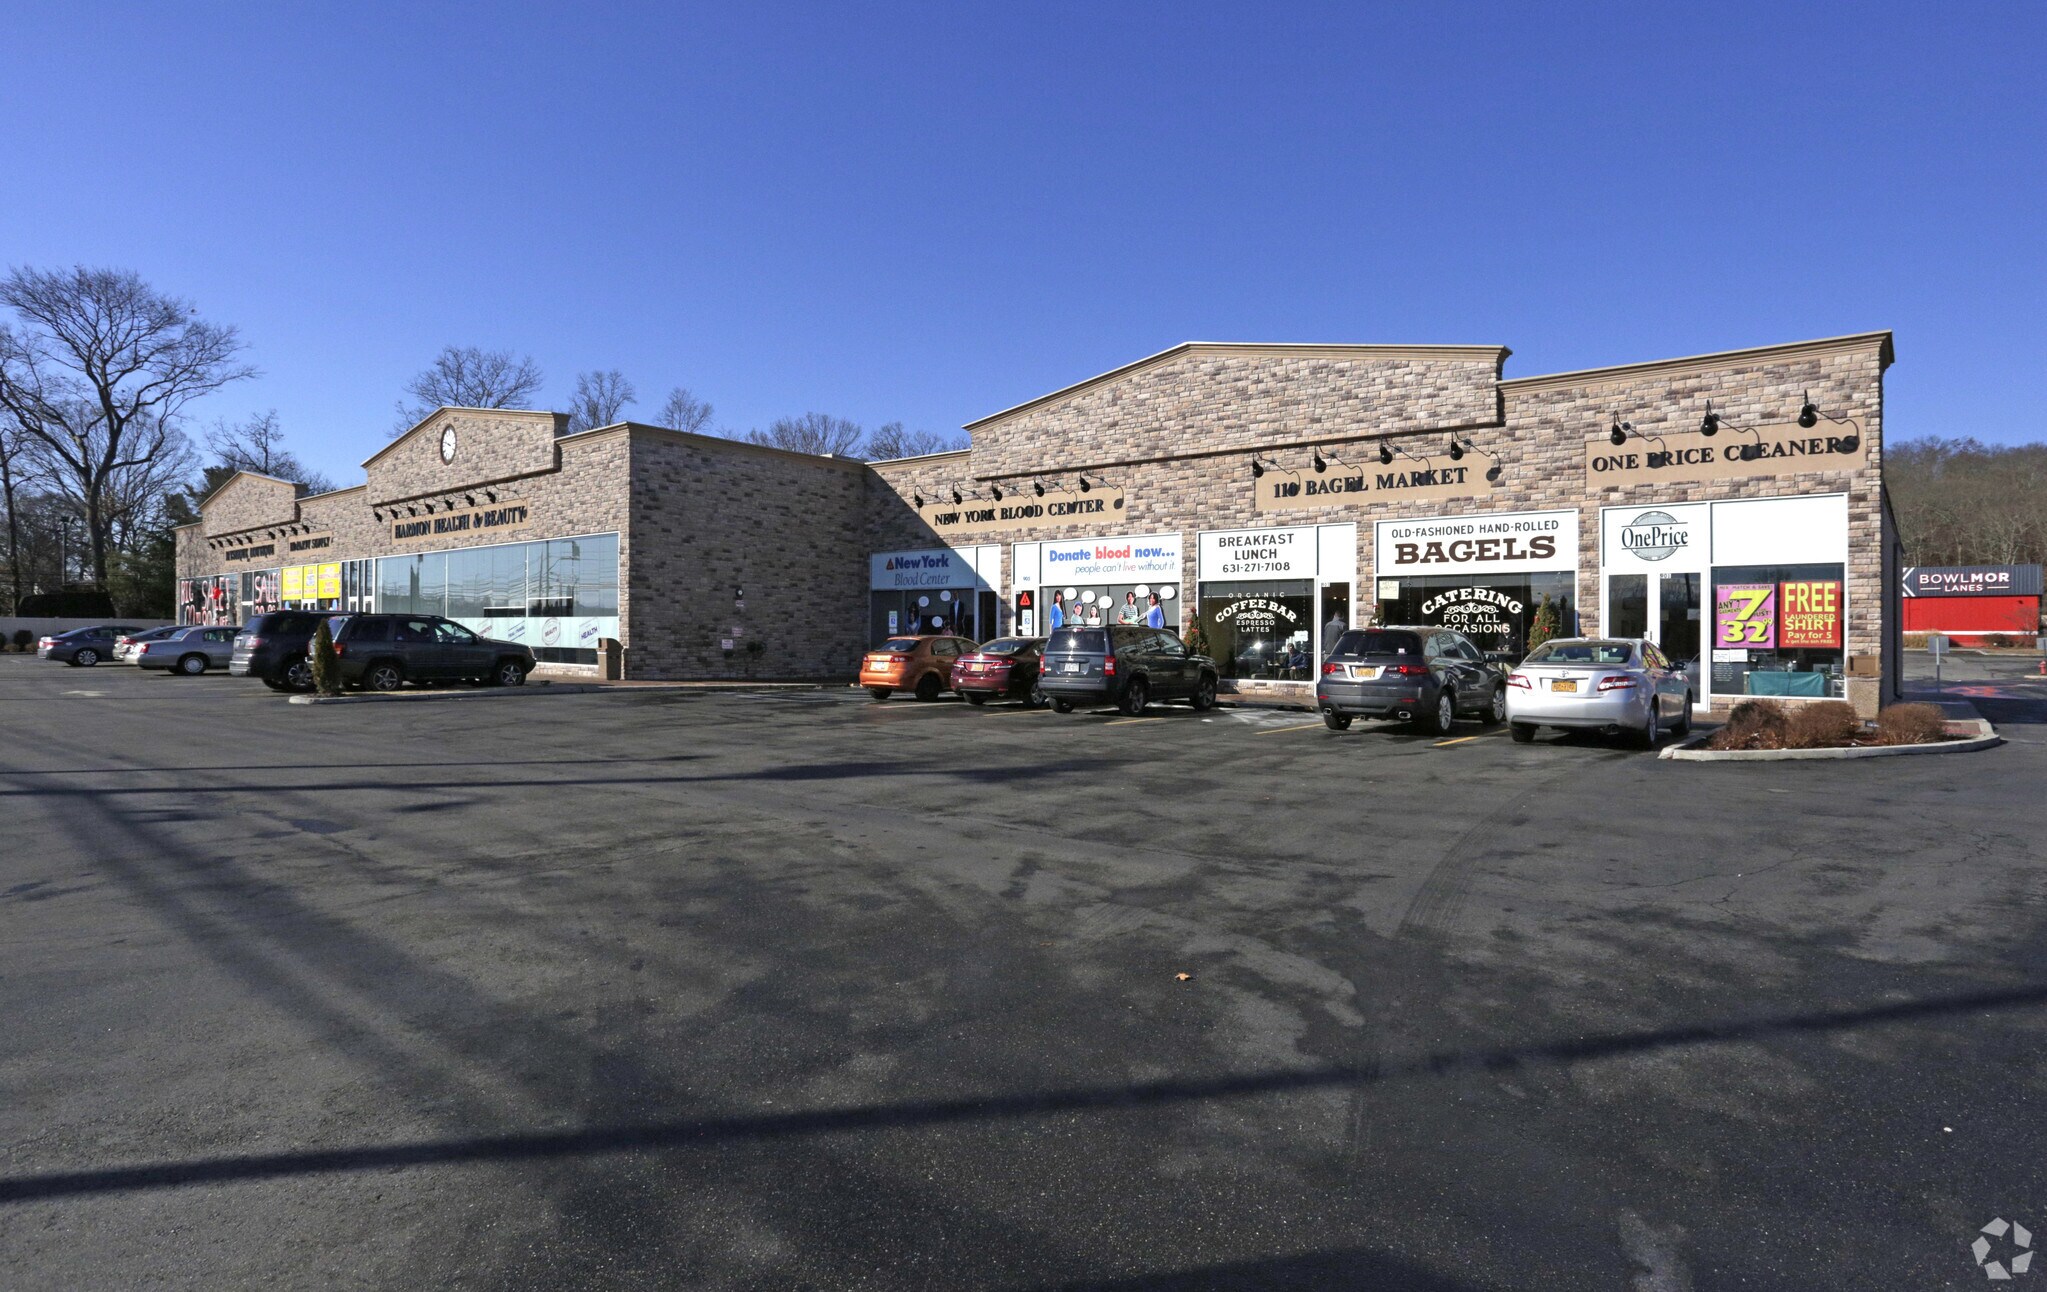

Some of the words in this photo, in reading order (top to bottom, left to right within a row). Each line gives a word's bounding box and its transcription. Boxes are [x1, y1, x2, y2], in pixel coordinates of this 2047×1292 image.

[1592, 455, 1639, 472] ONE
[1646, 447, 1715, 469] PRICE
[1274, 481, 1298, 498] 110
[1305, 476, 1368, 495] BAGEL
[1376, 467, 1468, 489] MARKET
[934, 512, 961, 526] NEW
[965, 508, 997, 523] YORK
[1000, 504, 1044, 520] BLOOD
[1047, 498, 1105, 516] CENTER
[395, 520, 431, 539] HARMON
[434, 514, 471, 534] HEALTH
[473, 512, 483, 529] &
[484, 506, 526, 527] BEAUTY
[1391, 524, 1474, 539] OLD-FASHIONED
[1479, 520, 1559, 534] HAND-ROLLED
[1218, 533, 1295, 548] BREAKFAST
[1621, 526, 1688, 549] OnePrice
[1049, 549, 1091, 562] Donate
[1095, 545, 1131, 559] blood
[1134, 547, 1175, 558] now...
[1234, 548, 1278, 560] LUNCH
[1395, 535, 1556, 565] BAGELS
[894, 556, 921, 569] New
[920, 553, 949, 568] York
[1074, 564, 1101, 576] people
[1102, 561, 1122, 573] can't
[1122, 560, 1136, 572] live
[1137, 560, 1169, 571] without
[1222, 561, 1290, 573] 631-271-7108
[894, 572, 919, 586] Blood
[919, 571, 950, 585] Center
[1919, 572, 2010, 584] BOWLMOR
[181, 580, 194, 606] BIG
[201, 576, 230, 612] SALE!
[1944, 584, 1983, 592] LANES
[1421, 587, 1524, 615] CATERING
[1718, 600, 1733, 610] ANY
[1729, 589, 1773, 621] 7
[1784, 582, 1836, 613] FREE
[1214, 599, 1267, 624] COFFEE
[1267, 601, 1298, 623] BAR
[1443, 614, 1470, 624] FOR
[1476, 614, 1501, 623] ALL
[1784, 613, 1836, 621] LAUNDERED
[544, 626, 558, 638] BEAUTY
[581, 626, 598, 640] HEALTH
[1784, 619, 1836, 631] SHIRT
[1787, 631, 1806, 641] Pay
[1808, 631, 1824, 639] for
[1826, 631, 1833, 639] 5
